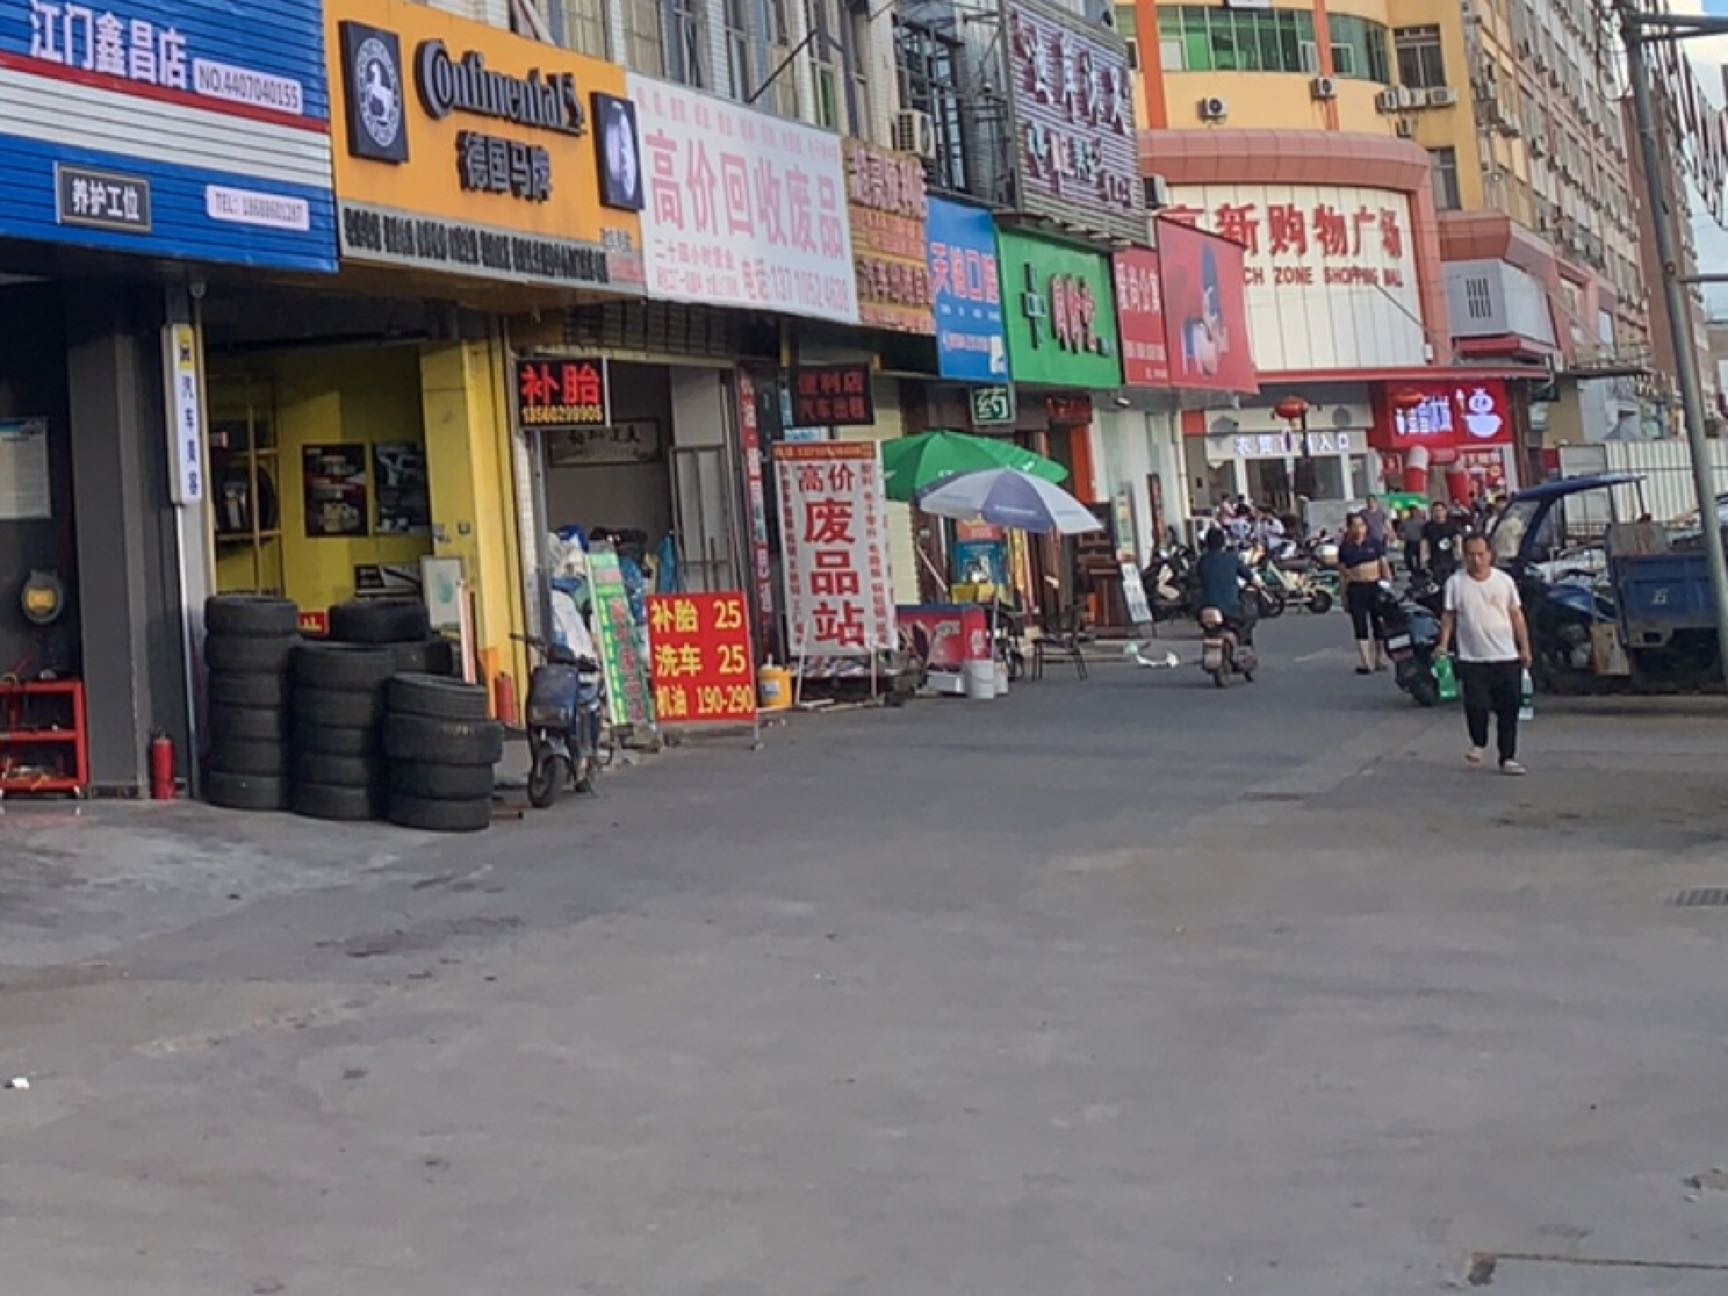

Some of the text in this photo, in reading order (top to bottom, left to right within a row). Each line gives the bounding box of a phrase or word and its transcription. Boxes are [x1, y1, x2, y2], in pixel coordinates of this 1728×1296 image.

[416, 40, 565, 128] Continental
[457, 131, 552, 202] 德国马牌
[72, 178, 139, 219] 养护工位
[645, 129, 844, 260] 高价回收废品
[1274, 266, 1312, 285] ZONE
[520, 363, 601, 405] 补胎
[1235, 432, 1350, 455] 农贸入口
[797, 462, 855, 493] 高价
[804, 498, 864, 647] 废品站
[651, 599, 743, 633] 补胎 25
[655, 643, 747, 677] 洗车 25
[656, 685, 753, 717] 机油 190-290
